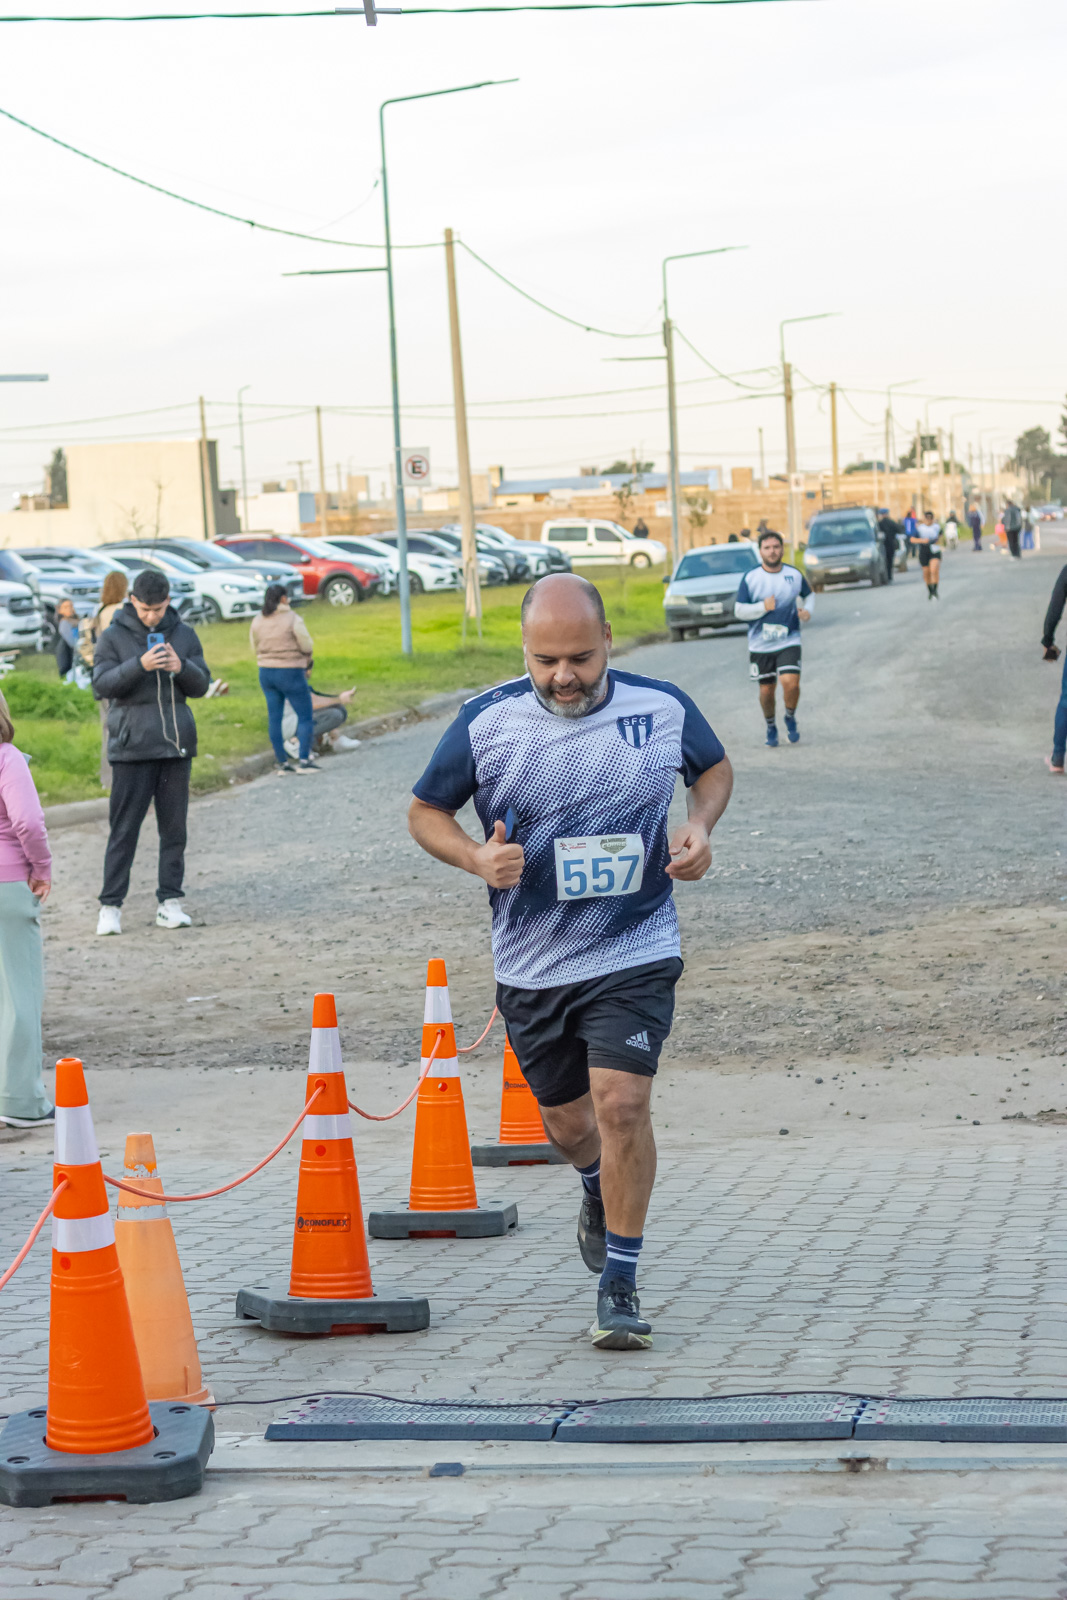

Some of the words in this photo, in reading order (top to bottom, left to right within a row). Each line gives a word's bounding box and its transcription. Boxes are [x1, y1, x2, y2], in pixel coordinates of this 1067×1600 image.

[412, 460, 422, 474] E
[623, 717, 646, 726] SFC
[563, 855, 639, 896] 557
[625, 1038, 651, 1052] adidas
[304, 1219, 348, 1227] CONOFLEX
